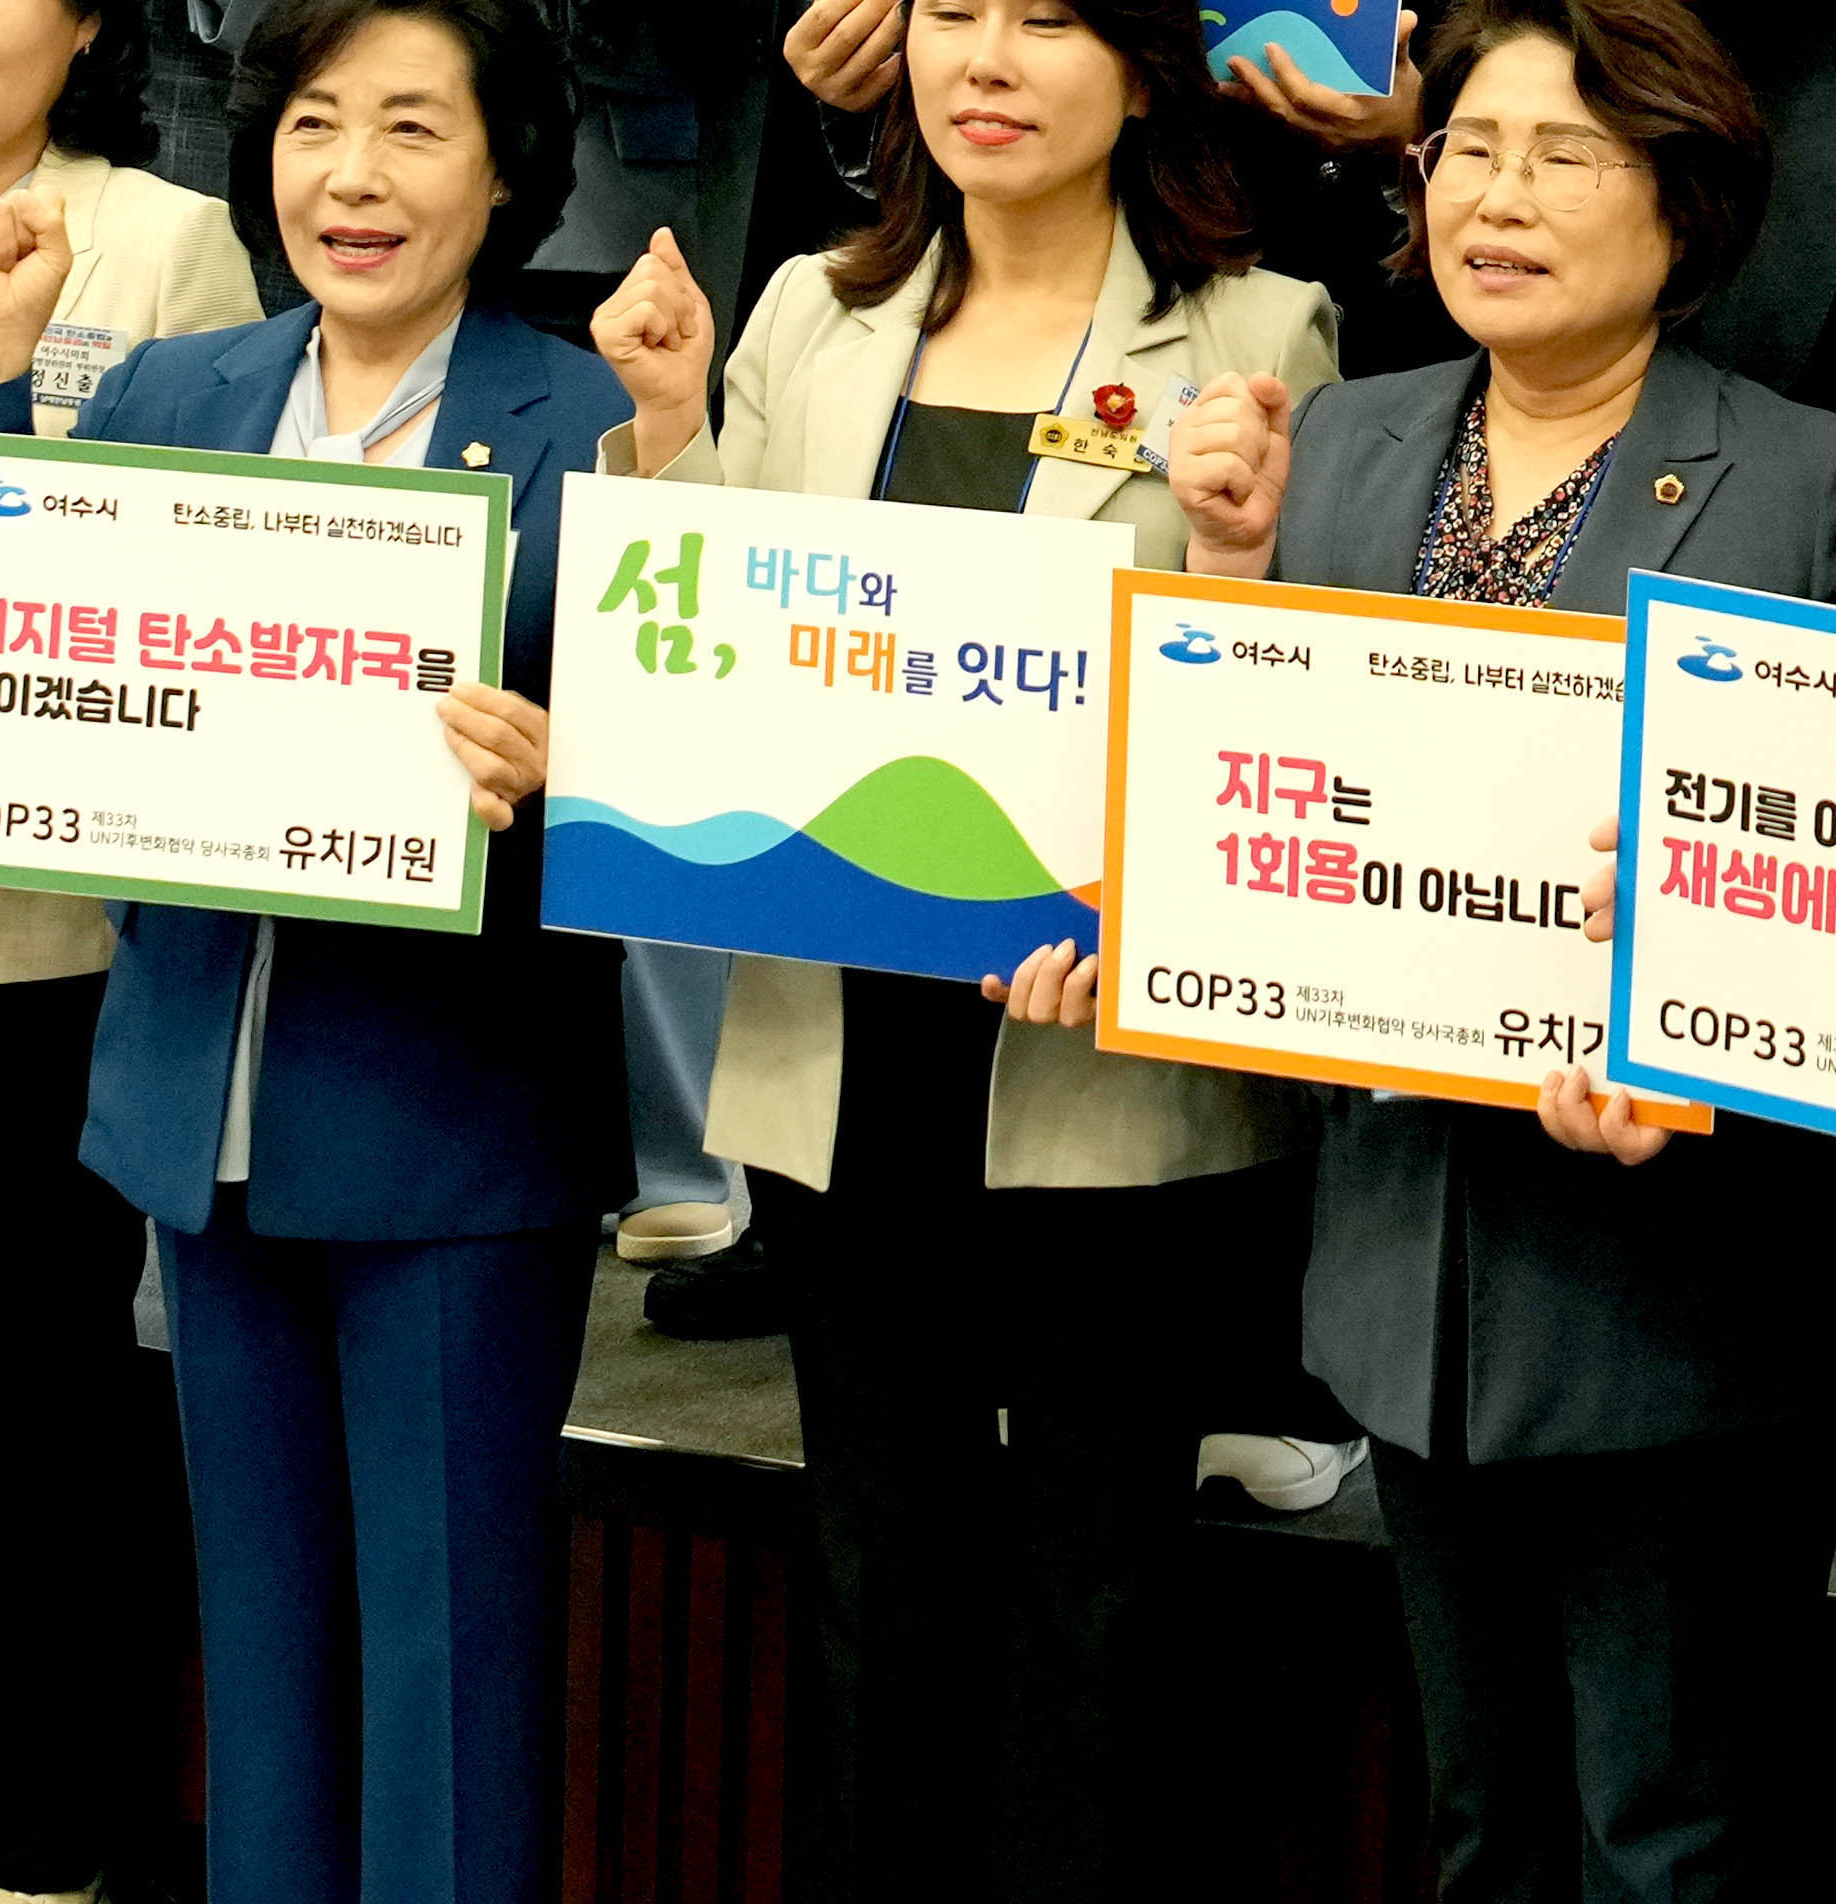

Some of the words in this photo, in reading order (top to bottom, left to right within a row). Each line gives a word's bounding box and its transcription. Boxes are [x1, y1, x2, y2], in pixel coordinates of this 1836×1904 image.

[596, 532, 737, 679] 섬,
[747, 547, 898, 617] 바다와
[139, 612, 459, 698] 탄소발자국을
[790, 624, 938, 695] 미래를
[958, 642, 1087, 712] 잇다!
[1216, 751, 1372, 825] 지구는
[1665, 769, 1797, 841] 전기를
[279, 827, 435, 882] 유치기원
[1216, 832, 1402, 909] 1회용이
[1148, 967, 1285, 1019] COP33
[1660, 1000, 1805, 1067] COP33
